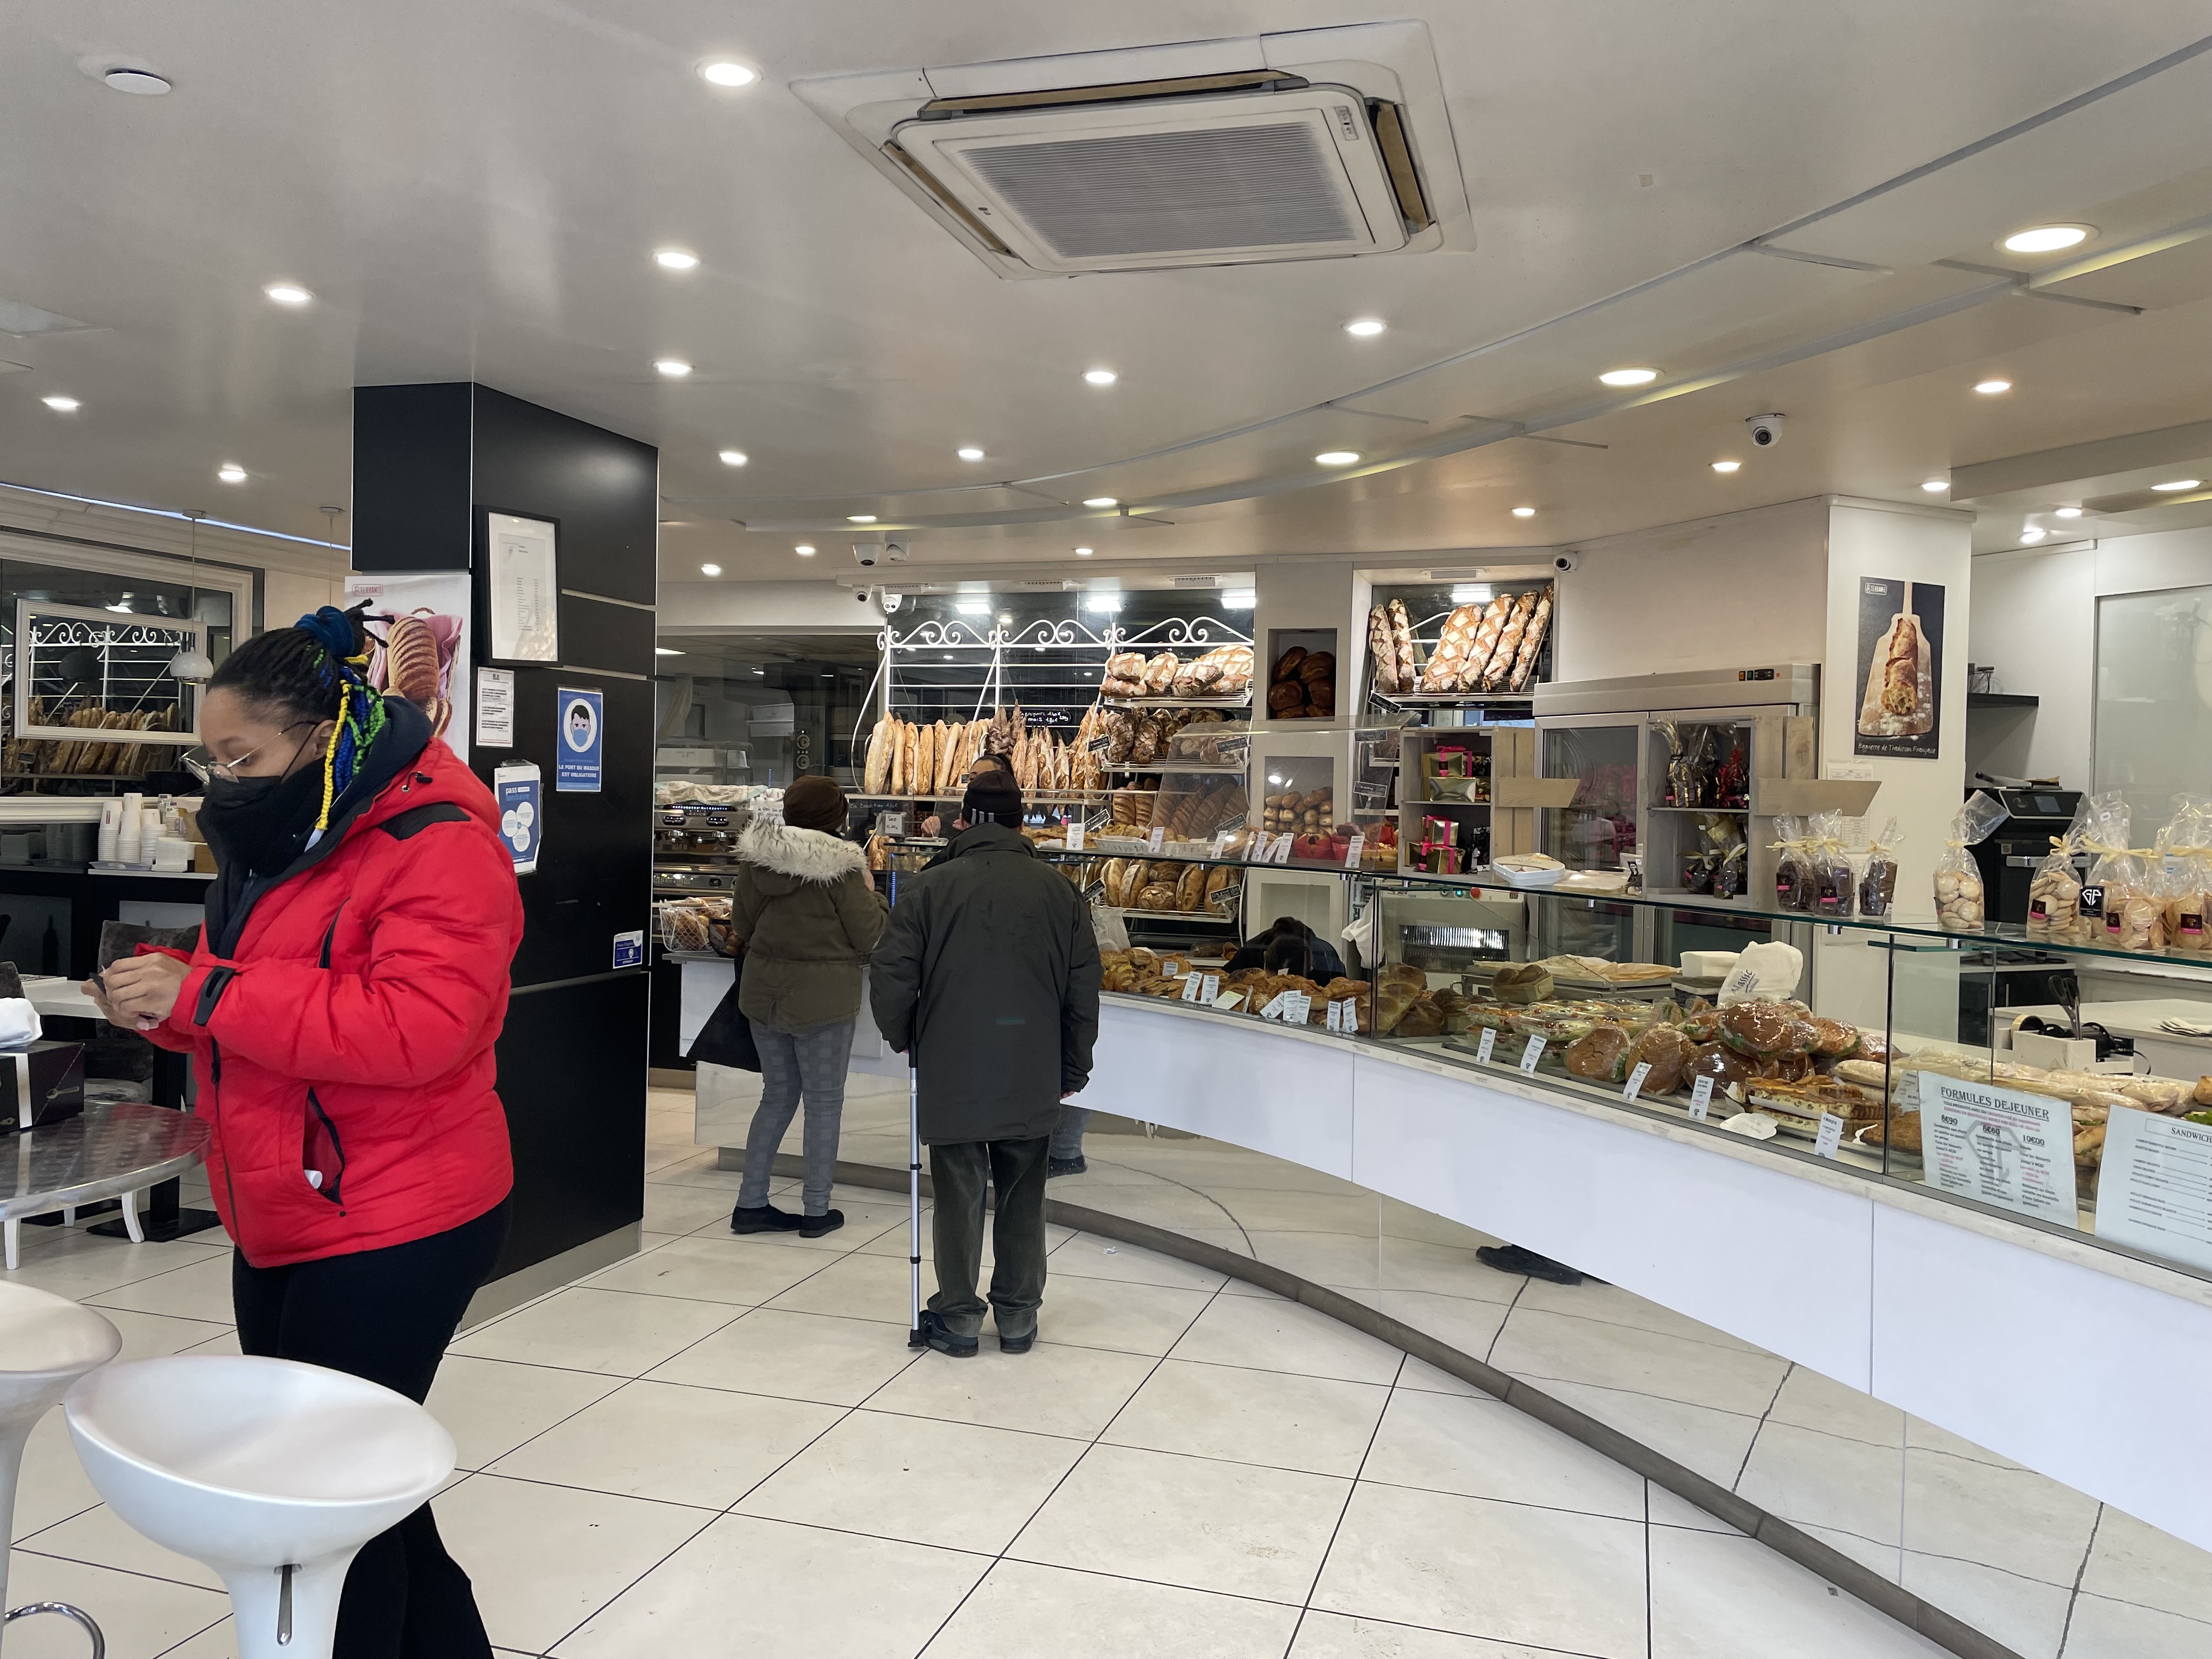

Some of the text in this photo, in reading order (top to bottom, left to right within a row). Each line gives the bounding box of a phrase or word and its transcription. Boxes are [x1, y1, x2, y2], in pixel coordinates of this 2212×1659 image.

[1858, 742, 1880, 753] Baguette
[505, 787, 517, 796] pass
[506, 793, 530, 802] sanitaire
[1940, 1086, 2050, 1120] FORMULES DEJEUNER
